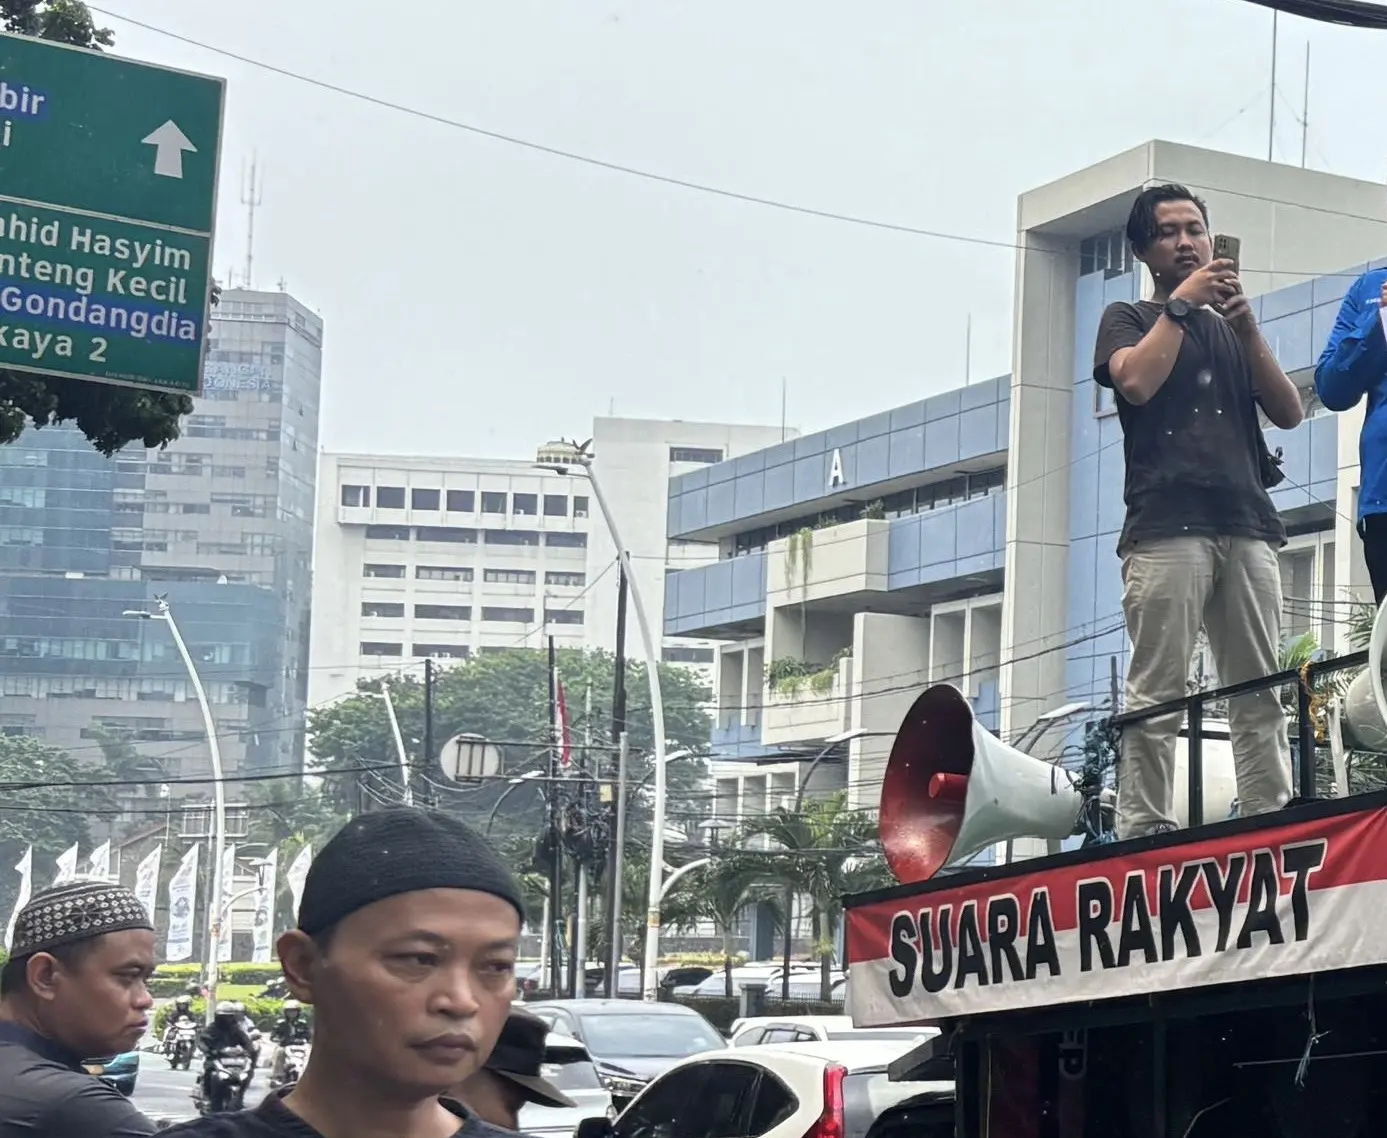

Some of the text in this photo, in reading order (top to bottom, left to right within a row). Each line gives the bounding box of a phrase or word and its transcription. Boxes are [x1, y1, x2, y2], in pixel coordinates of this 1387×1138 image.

[71, 226, 191, 270] Hasyim
[107, 268, 188, 304] Kecil
[2, 287, 196, 340] Gondangdia
[89, 337, 108, 363] 2
[829, 447, 844, 487] A
[889, 838, 1328, 998] SUARA RAKYAT
